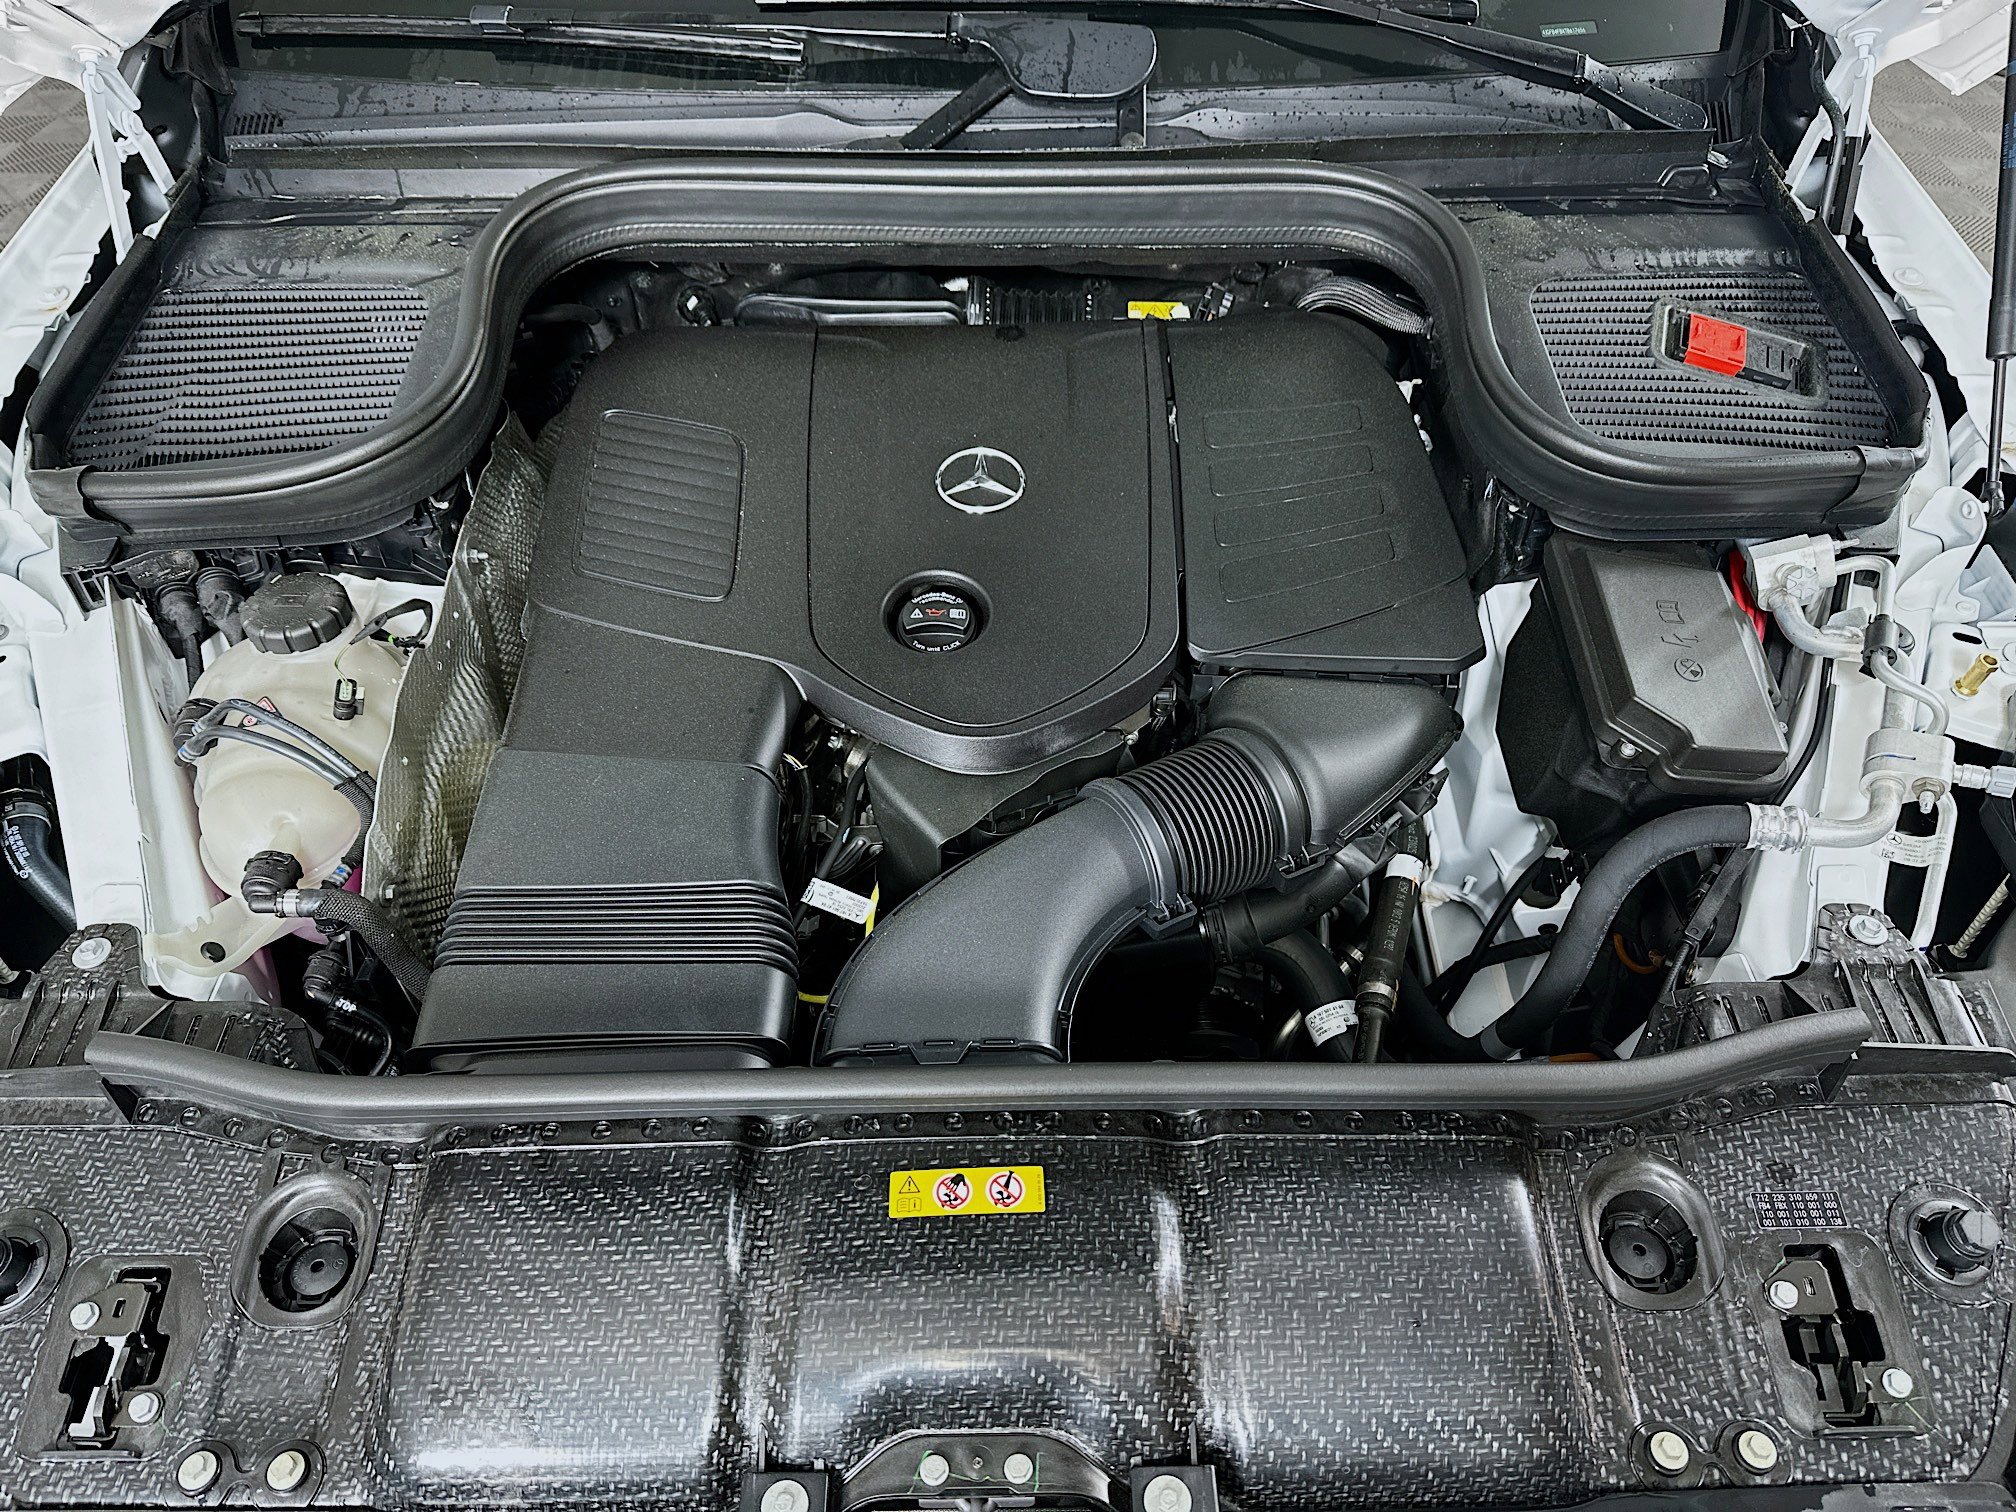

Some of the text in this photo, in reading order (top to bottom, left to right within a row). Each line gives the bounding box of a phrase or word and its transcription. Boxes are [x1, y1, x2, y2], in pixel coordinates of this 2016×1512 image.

[912, 640, 926, 650] Turn
[942, 640, 961, 651] CLICK
[335, 998, 357, 1013] TOP
[1788, 1193, 1802, 1201] 310
[1805, 1193, 1818, 1201] 659
[1758, 1202, 1771, 1210] FB4
[1807, 1201, 1821, 1209] 001
[1823, 1201, 1838, 1209] 000
[1761, 1210, 1774, 1218] 110
[1776, 1210, 1790, 1218] 001
[1793, 1210, 1807, 1218] 010
[1826, 1209, 1840, 1217] 011
[1795, 1218, 1810, 1226] 010
[1813, 1218, 1826, 1226] 100
